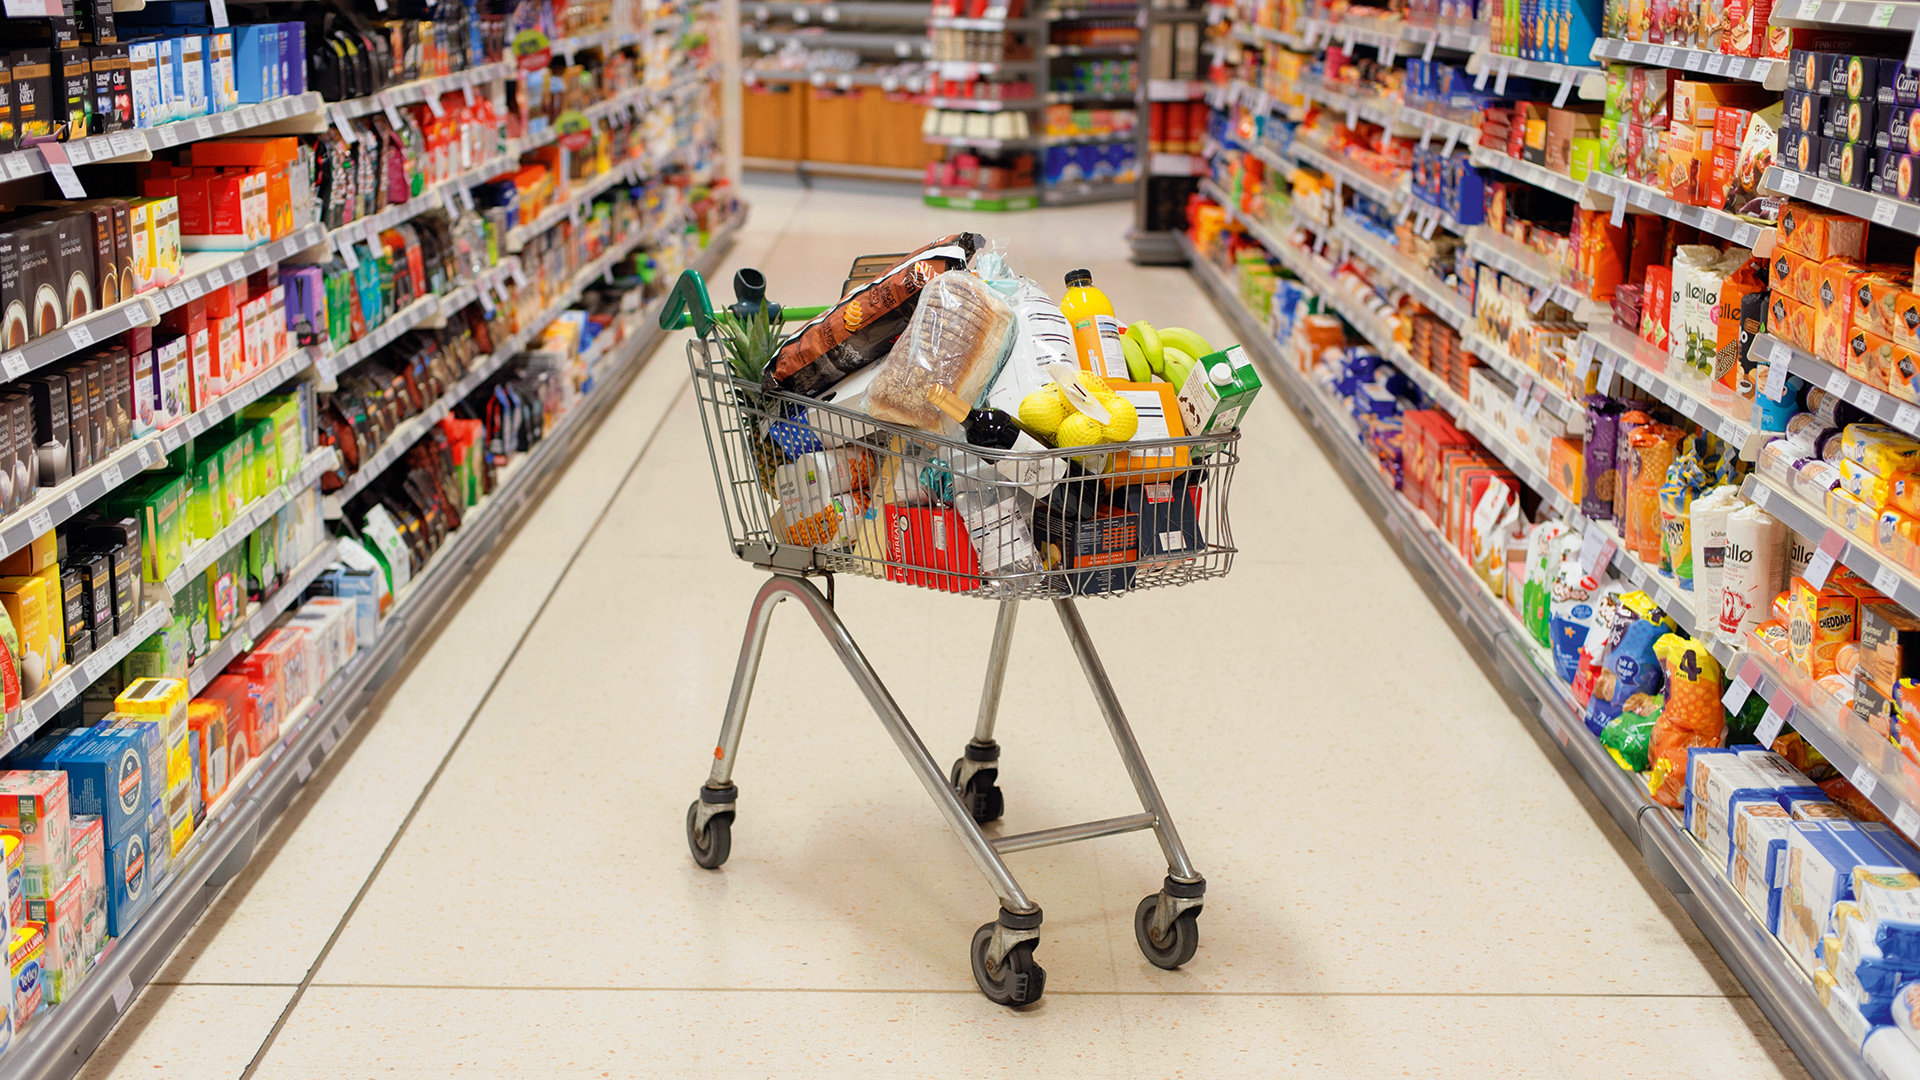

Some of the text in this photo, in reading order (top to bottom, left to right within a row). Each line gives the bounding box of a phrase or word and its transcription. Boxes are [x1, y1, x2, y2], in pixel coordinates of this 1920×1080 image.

[1814, 40, 1854, 49] FINN CRISP
[1896, 74, 1918, 92] Carr's
[96, 586, 105, 599] Earl
[96, 595, 109, 612] GREY
[1818, 614, 1852, 629] CHEDDARS
[1619, 658, 1628, 667] Salt
[1680, 650, 1702, 682] 4
[1618, 666, 1634, 678] Vinegar
[19, 962, 38, 992] Tetley
